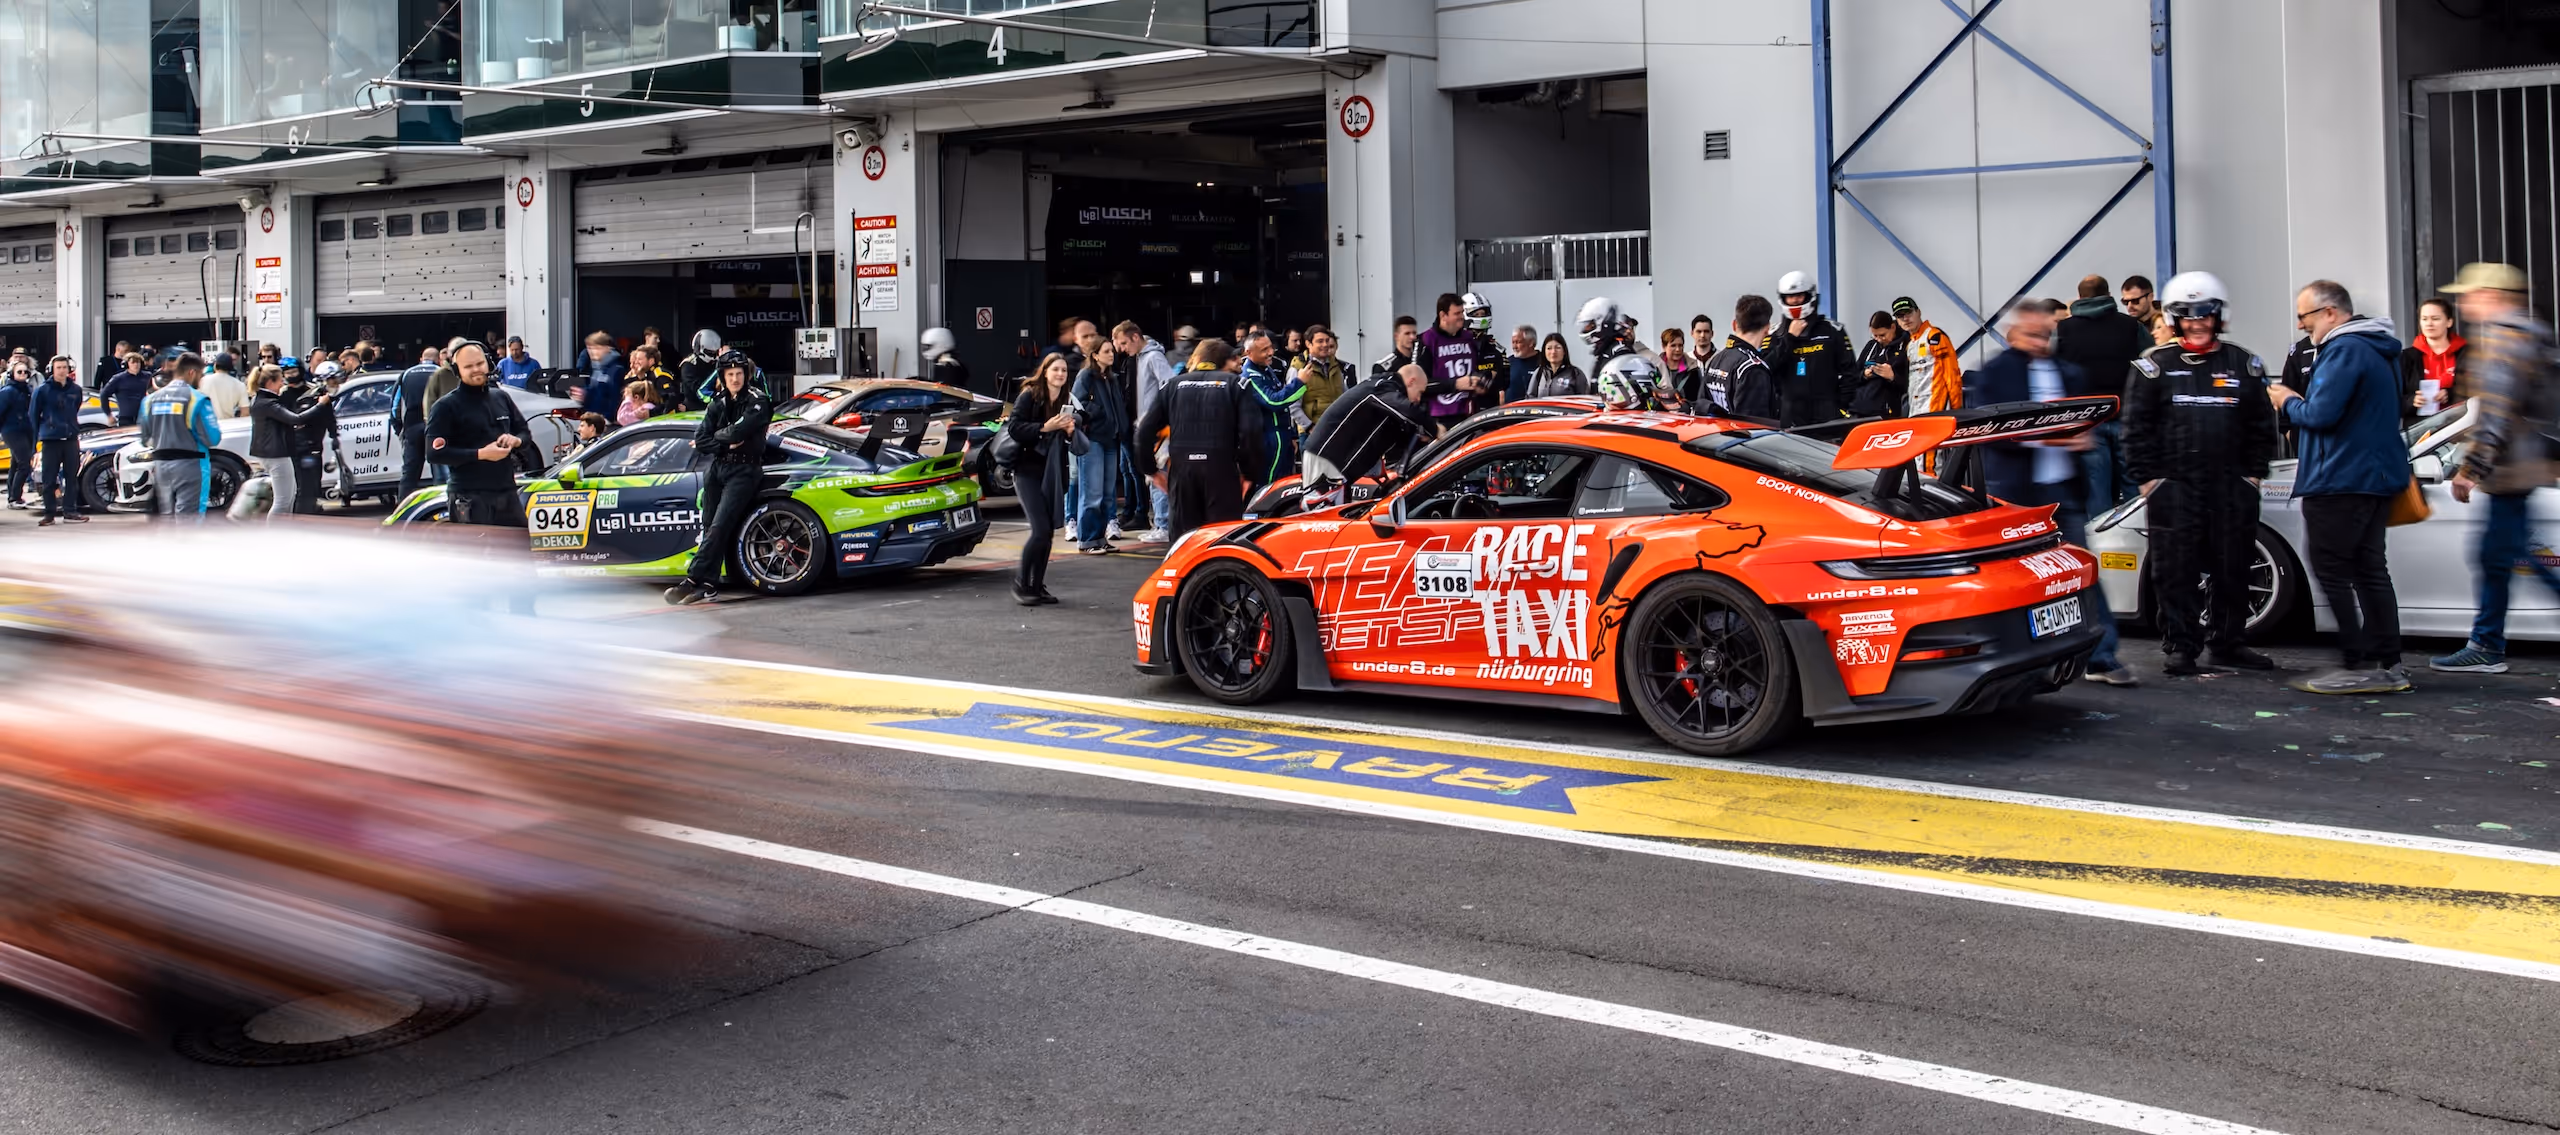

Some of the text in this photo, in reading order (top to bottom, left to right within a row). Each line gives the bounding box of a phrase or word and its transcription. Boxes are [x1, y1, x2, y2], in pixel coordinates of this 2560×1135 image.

[987, 26, 1006, 65] 4
[580, 83, 595, 117] 5
[289, 125, 299, 154] 6
[1102, 207, 1152, 220] LOSCH
[860, 218, 887, 228] CAUTION
[858, 265, 890, 276] ACHTUNG
[749, 311, 800, 322] LOSCH
[1438, 343, 1472, 357] MEDIA
[1444, 358, 1473, 378] 167
[355, 433, 382, 444] build
[1952, 421, 2000, 439] eady
[1862, 430, 1914, 451] RS
[354, 448, 380, 459] build
[353, 464, 379, 475] build
[539, 493, 587, 503] RAVENOL
[1350, 485, 1368, 499] T13
[1756, 475, 1827, 505] BOOK NOW
[597, 492, 617, 506] PRO
[535, 507, 580, 530] 948
[628, 510, 703, 527] LOSCH
[541, 536, 581, 548] DEKRA
[840, 531, 876, 539] RAVENOL
[1472, 524, 1596, 582] RACE
[1418, 576, 1468, 593] 3108
[1806, 585, 1919, 601] under8.de
[2045, 575, 2082, 596] nürburgring
[1472, 589, 1589, 661] TAXI
[1844, 612, 1889, 622] RAVENOL
[1843, 622, 1898, 635] DIXCEL
[1846, 643, 1891, 666] KW
[1351, 659, 1456, 677] under8.de
[1476, 658, 1593, 689] nürburgring
[991, 712, 1550, 791] RAVENOL
